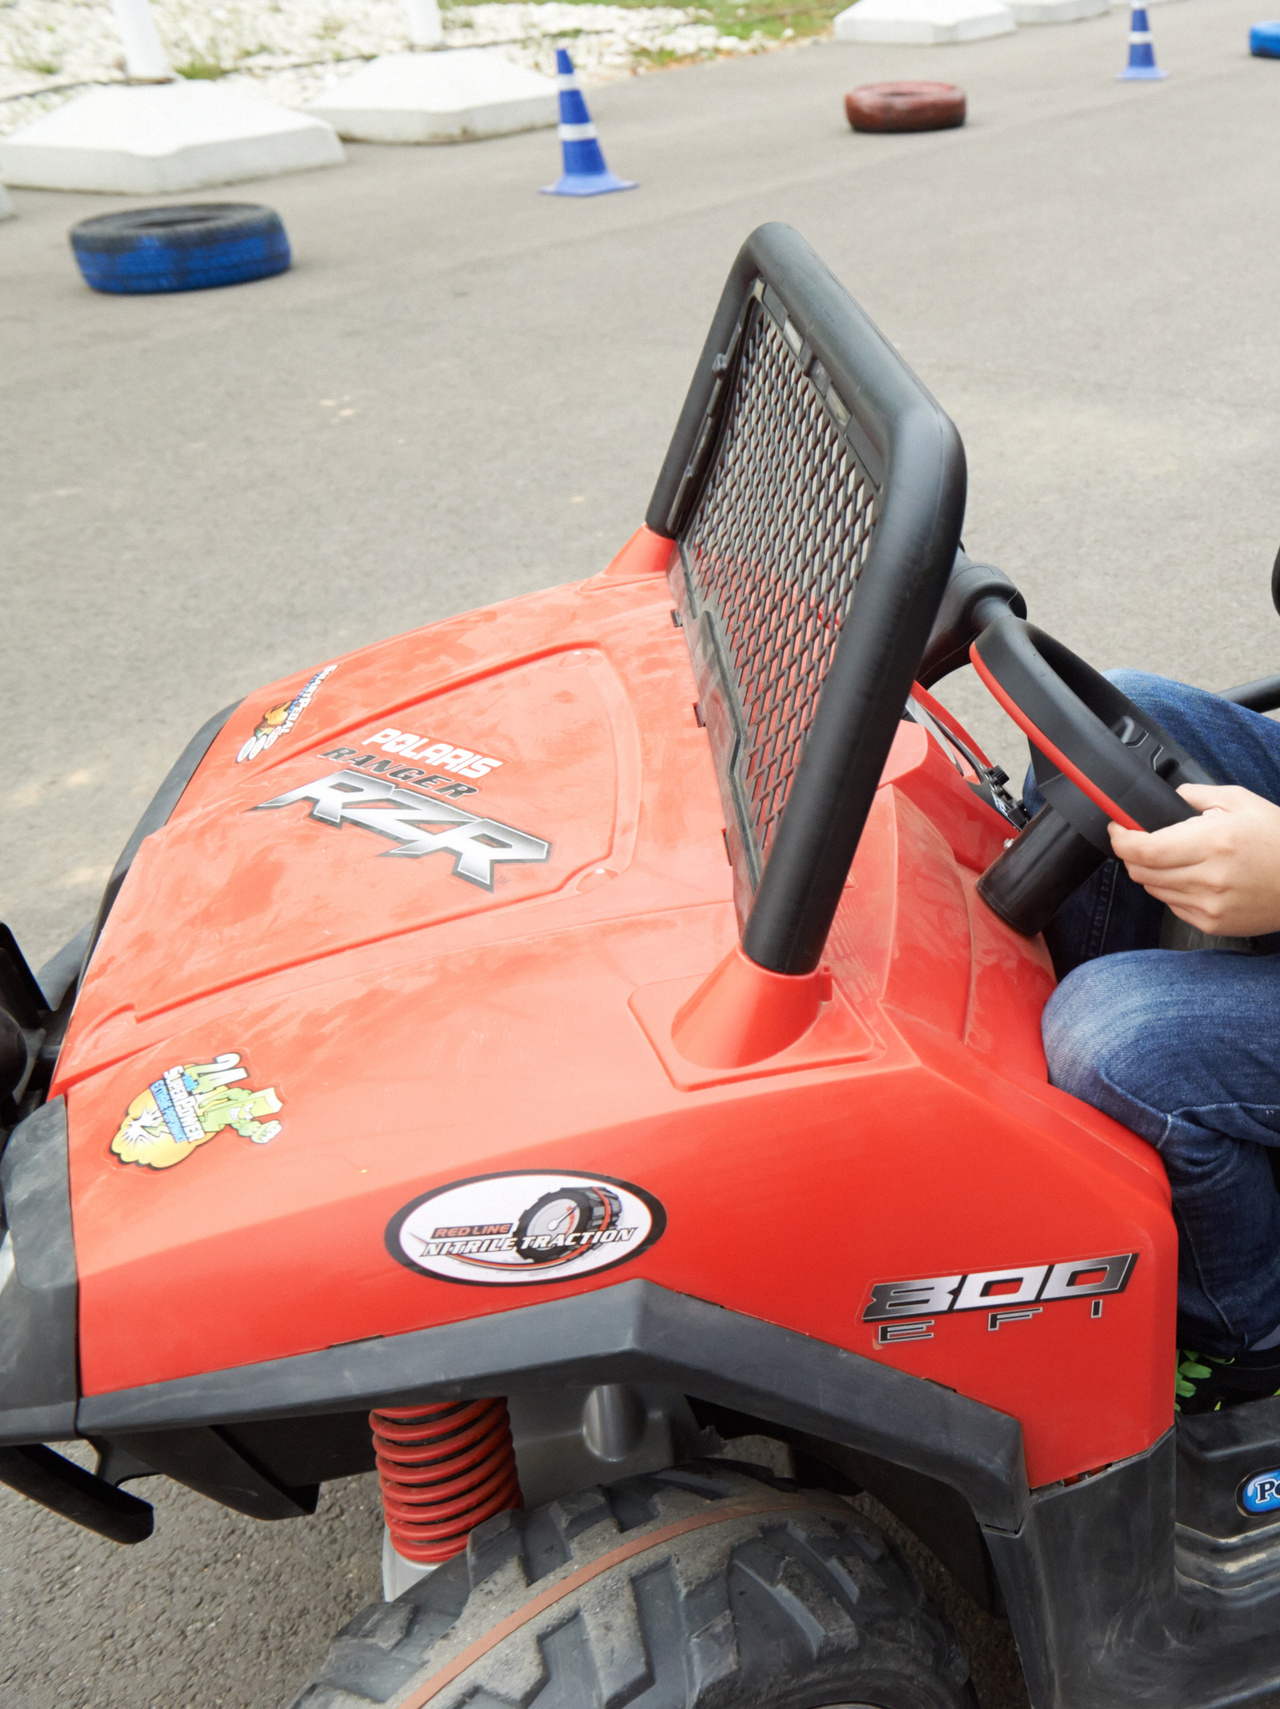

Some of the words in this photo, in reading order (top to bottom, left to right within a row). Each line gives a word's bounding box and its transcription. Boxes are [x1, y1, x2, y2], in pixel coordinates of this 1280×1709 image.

[317, 747, 479, 800] RANGER
[361, 728, 503, 779] POLARIS
[240, 769, 552, 893] RZR
[149, 1079, 174, 1113] EXTREME
[182, 1053, 249, 1097] 24
[419, 1236, 517, 1257] NITRILE
[520, 1226, 638, 1250] TRACTION
[861, 1252, 1140, 1324] 800
